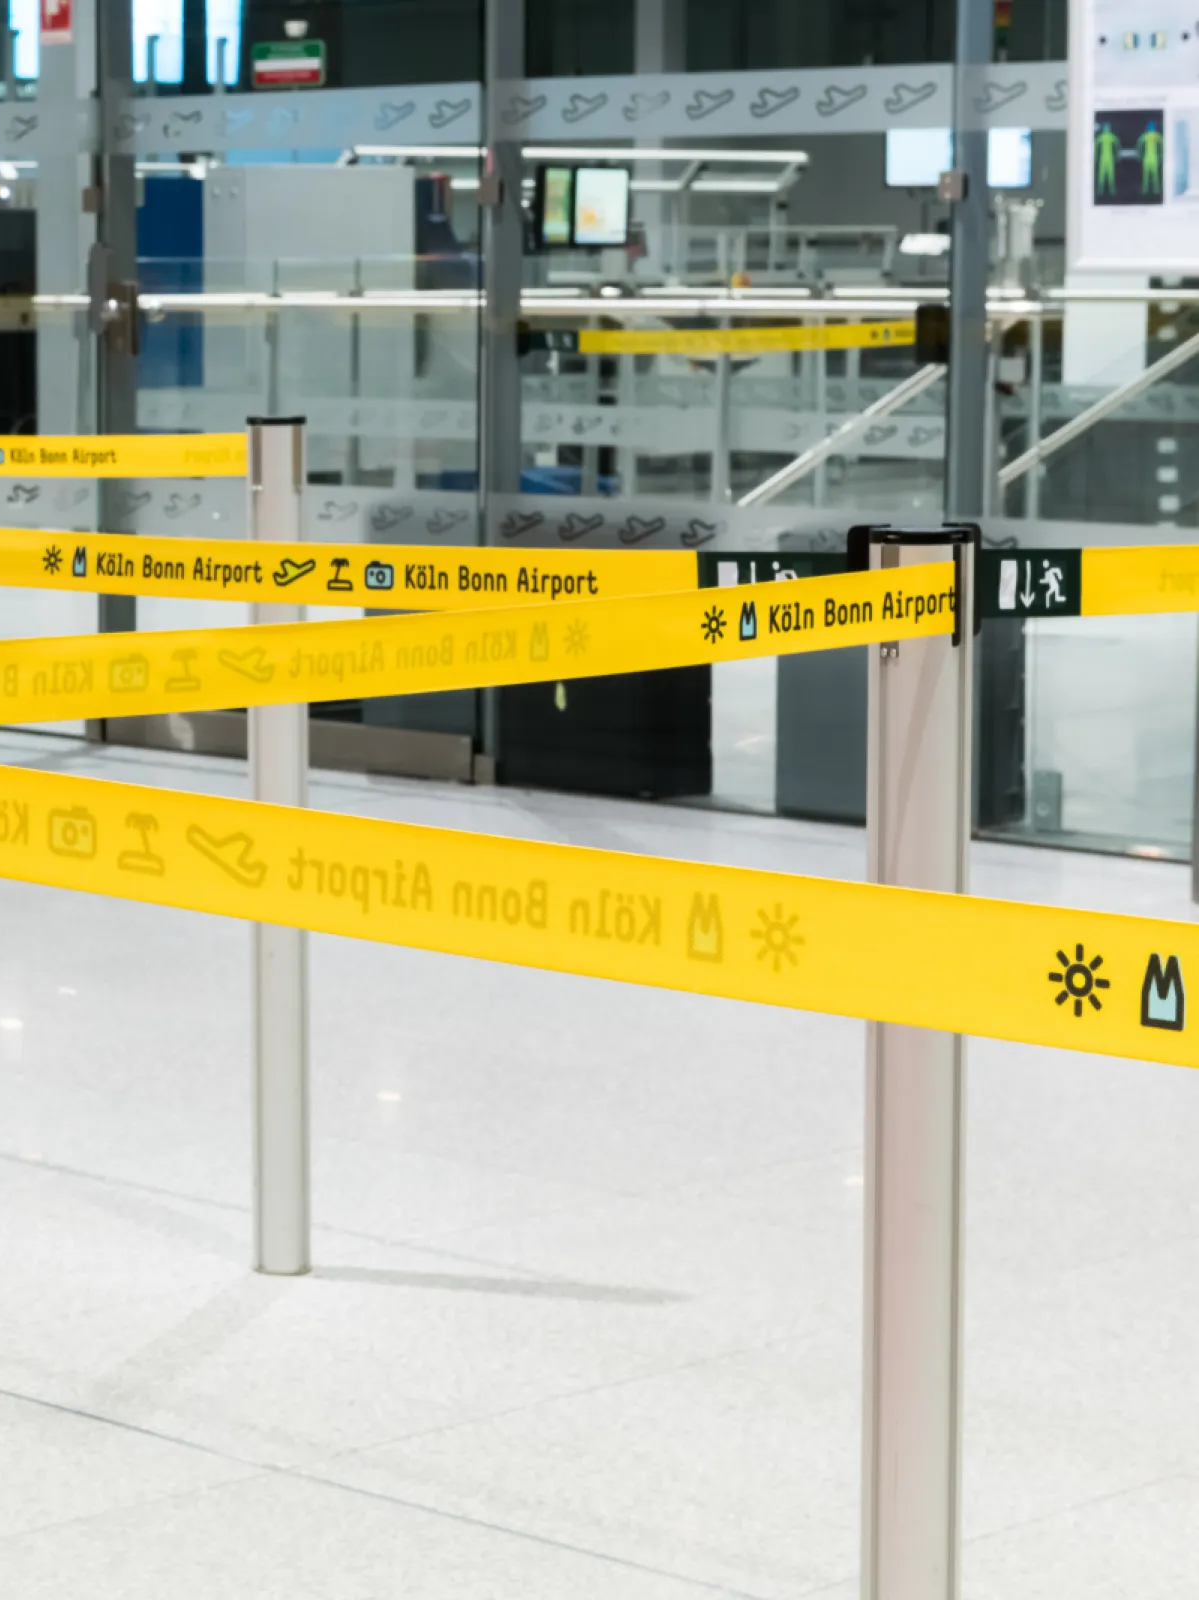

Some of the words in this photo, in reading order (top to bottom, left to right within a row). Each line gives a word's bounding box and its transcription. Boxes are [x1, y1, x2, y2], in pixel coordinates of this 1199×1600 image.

[97, 552, 133, 576] Köln
[143, 555, 182, 579] Bonn
[193, 557, 262, 588] Airport
[405, 564, 448, 590] Köln
[459, 565, 507, 592] Bonn
[517, 567, 598, 599] Airport
[770, 602, 814, 633] Köln
[824, 598, 872, 627] Bonn
[882, 585, 956, 625] Airport
